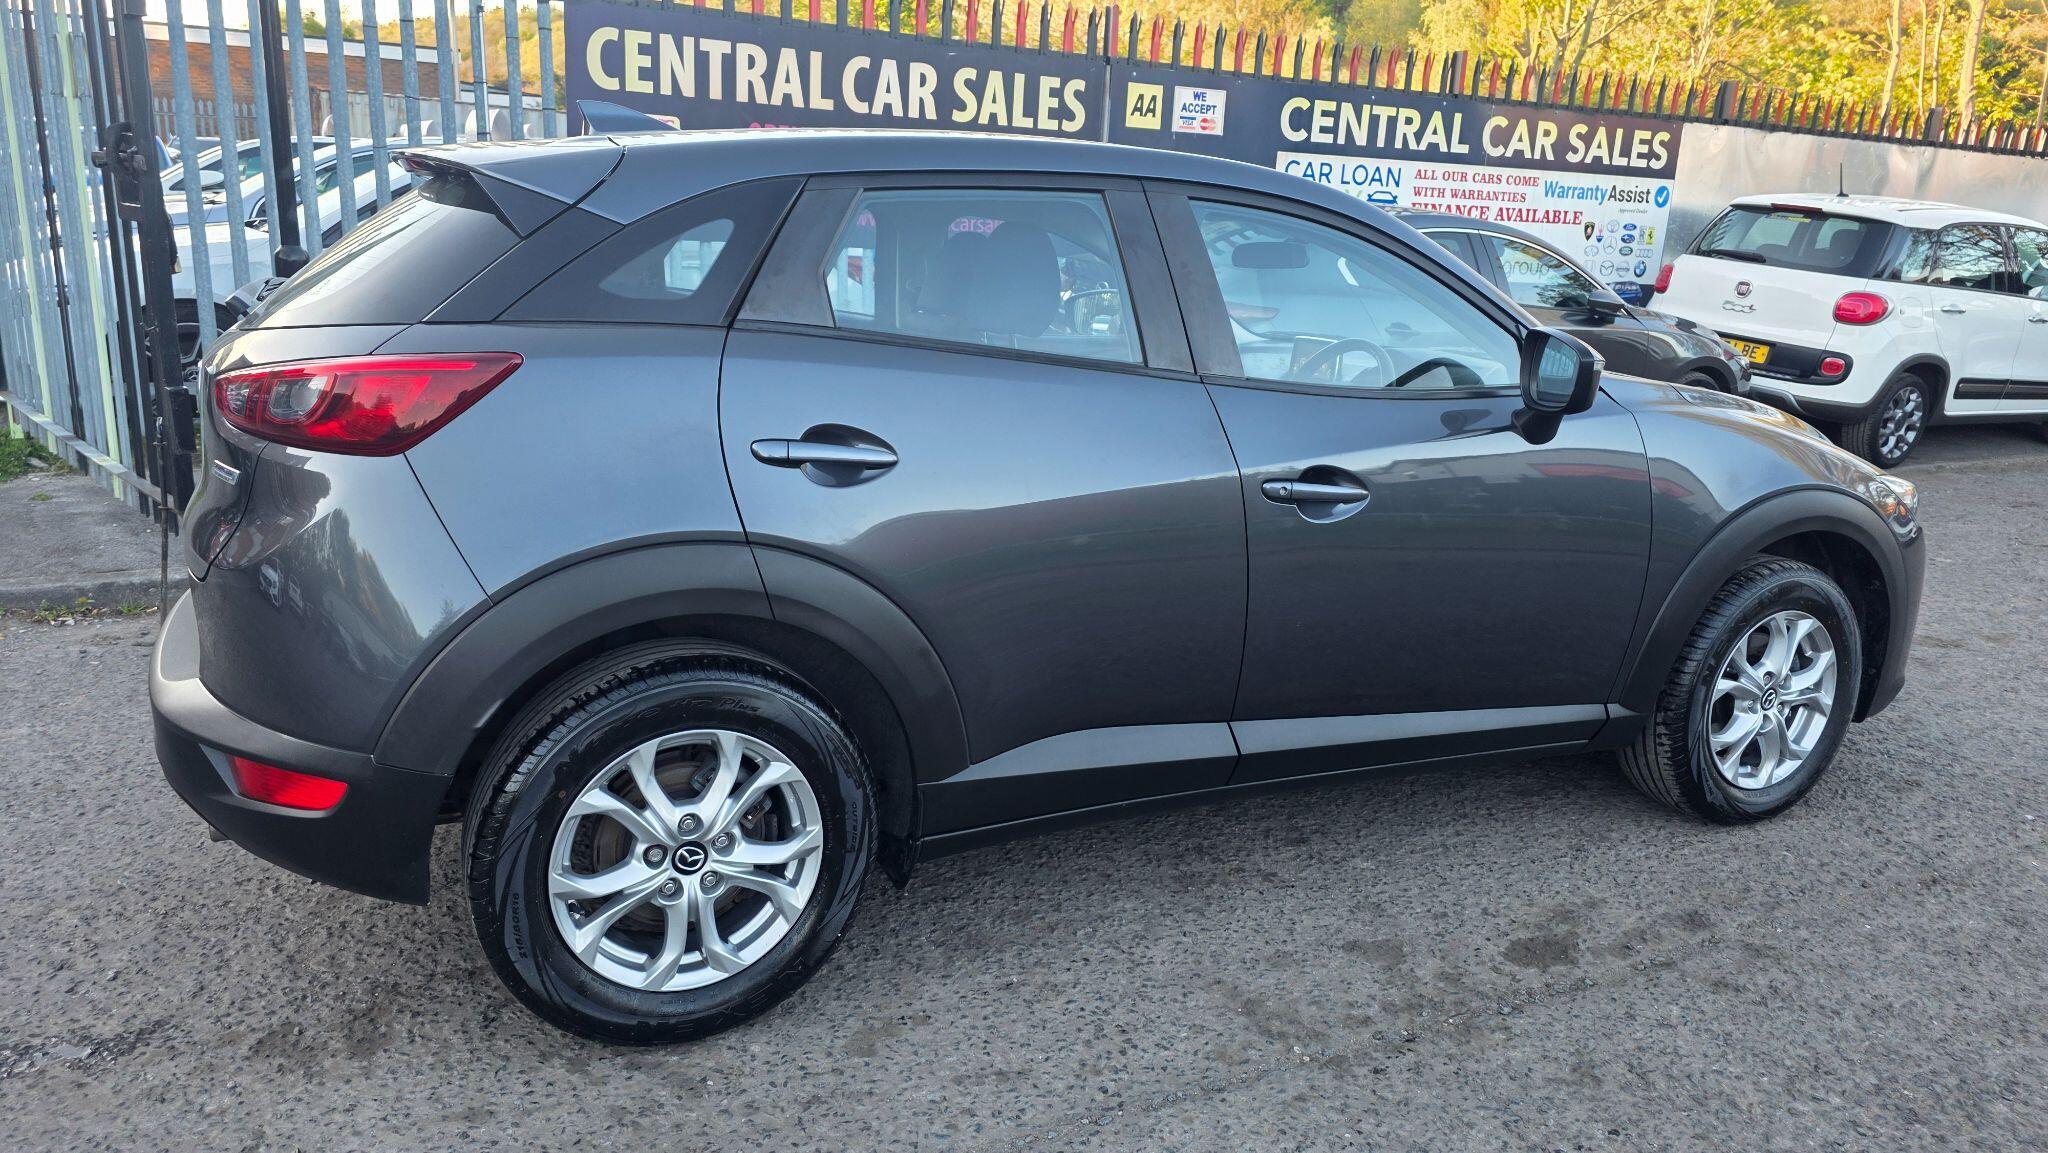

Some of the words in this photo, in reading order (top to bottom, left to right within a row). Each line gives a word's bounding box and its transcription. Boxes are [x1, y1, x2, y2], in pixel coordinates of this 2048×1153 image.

[586, 26, 834, 111] CENTRAL
[842, 55, 937, 121] CAR
[952, 66, 1086, 133] SALES
[1131, 93, 1158, 118] AA
[1193, 91, 1207, 102] WE
[1181, 103, 1217, 115] ACCEPT
[1280, 96, 1470, 155] CENTRAL
[1482, 115, 1558, 160] CAR
[1565, 125, 1671, 170] SALES
[1285, 159, 1333, 184] CAR
[1340, 163, 1402, 188] LOAN
[1414, 169, 1438, 181] ALL
[1442, 171, 1468, 183] OUR
[1472, 173, 1503, 185] CARS
[1506, 175, 1540, 187] COME
[1413, 186, 1446, 199] WITH
[1450, 189, 1527, 203] WARRANTIES
[1494, 207, 1583, 225] AVAILABLE
